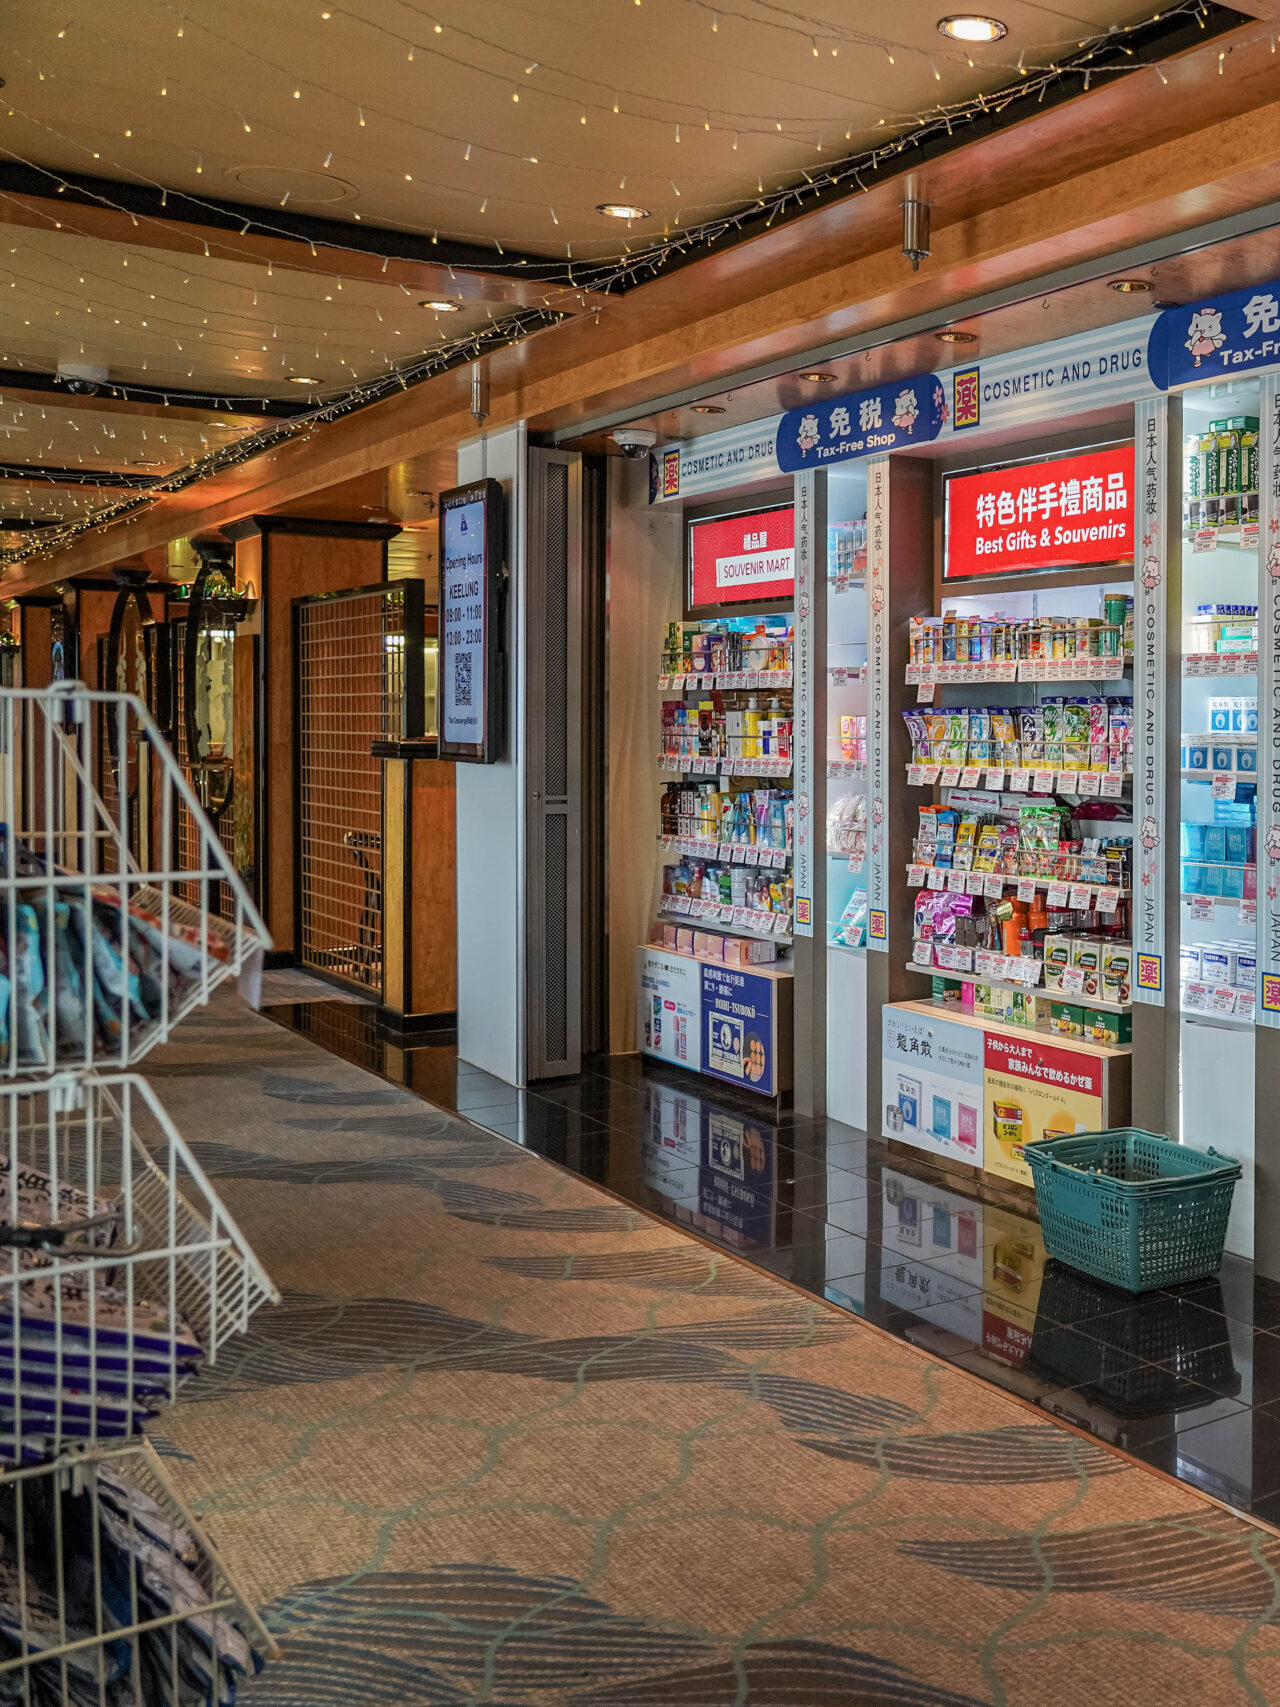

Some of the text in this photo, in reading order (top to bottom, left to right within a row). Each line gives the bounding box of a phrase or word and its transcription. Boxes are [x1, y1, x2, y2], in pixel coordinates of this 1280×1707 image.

[984, 349, 1142, 402] COSMETIC AND DRUG
[682, 441, 773, 476] COSMETIC AND DRUG
[816, 433, 896, 459] Tax-Free Shop
[976, 472, 1127, 528] 特色伴手禮商品
[975, 521, 1126, 555] Best Gifts & Souvenirs
[446, 552, 482, 571] Opening Hours
[724, 557, 790, 579] SOUVENIR MART
[450, 581, 478, 600] KEELUNG
[466, 604, 482, 620] 11:00
[466, 628, 482, 644] 23:00
[1145, 604, 1155, 806] COSMETIC AND DRUG
[1143, 895, 1155, 943] JAPAN
[987, 1039, 1032, 1058] 子供から大人まで
[1008, 1058, 1092, 1090] 家族みんなで飲めるかぜ薬
